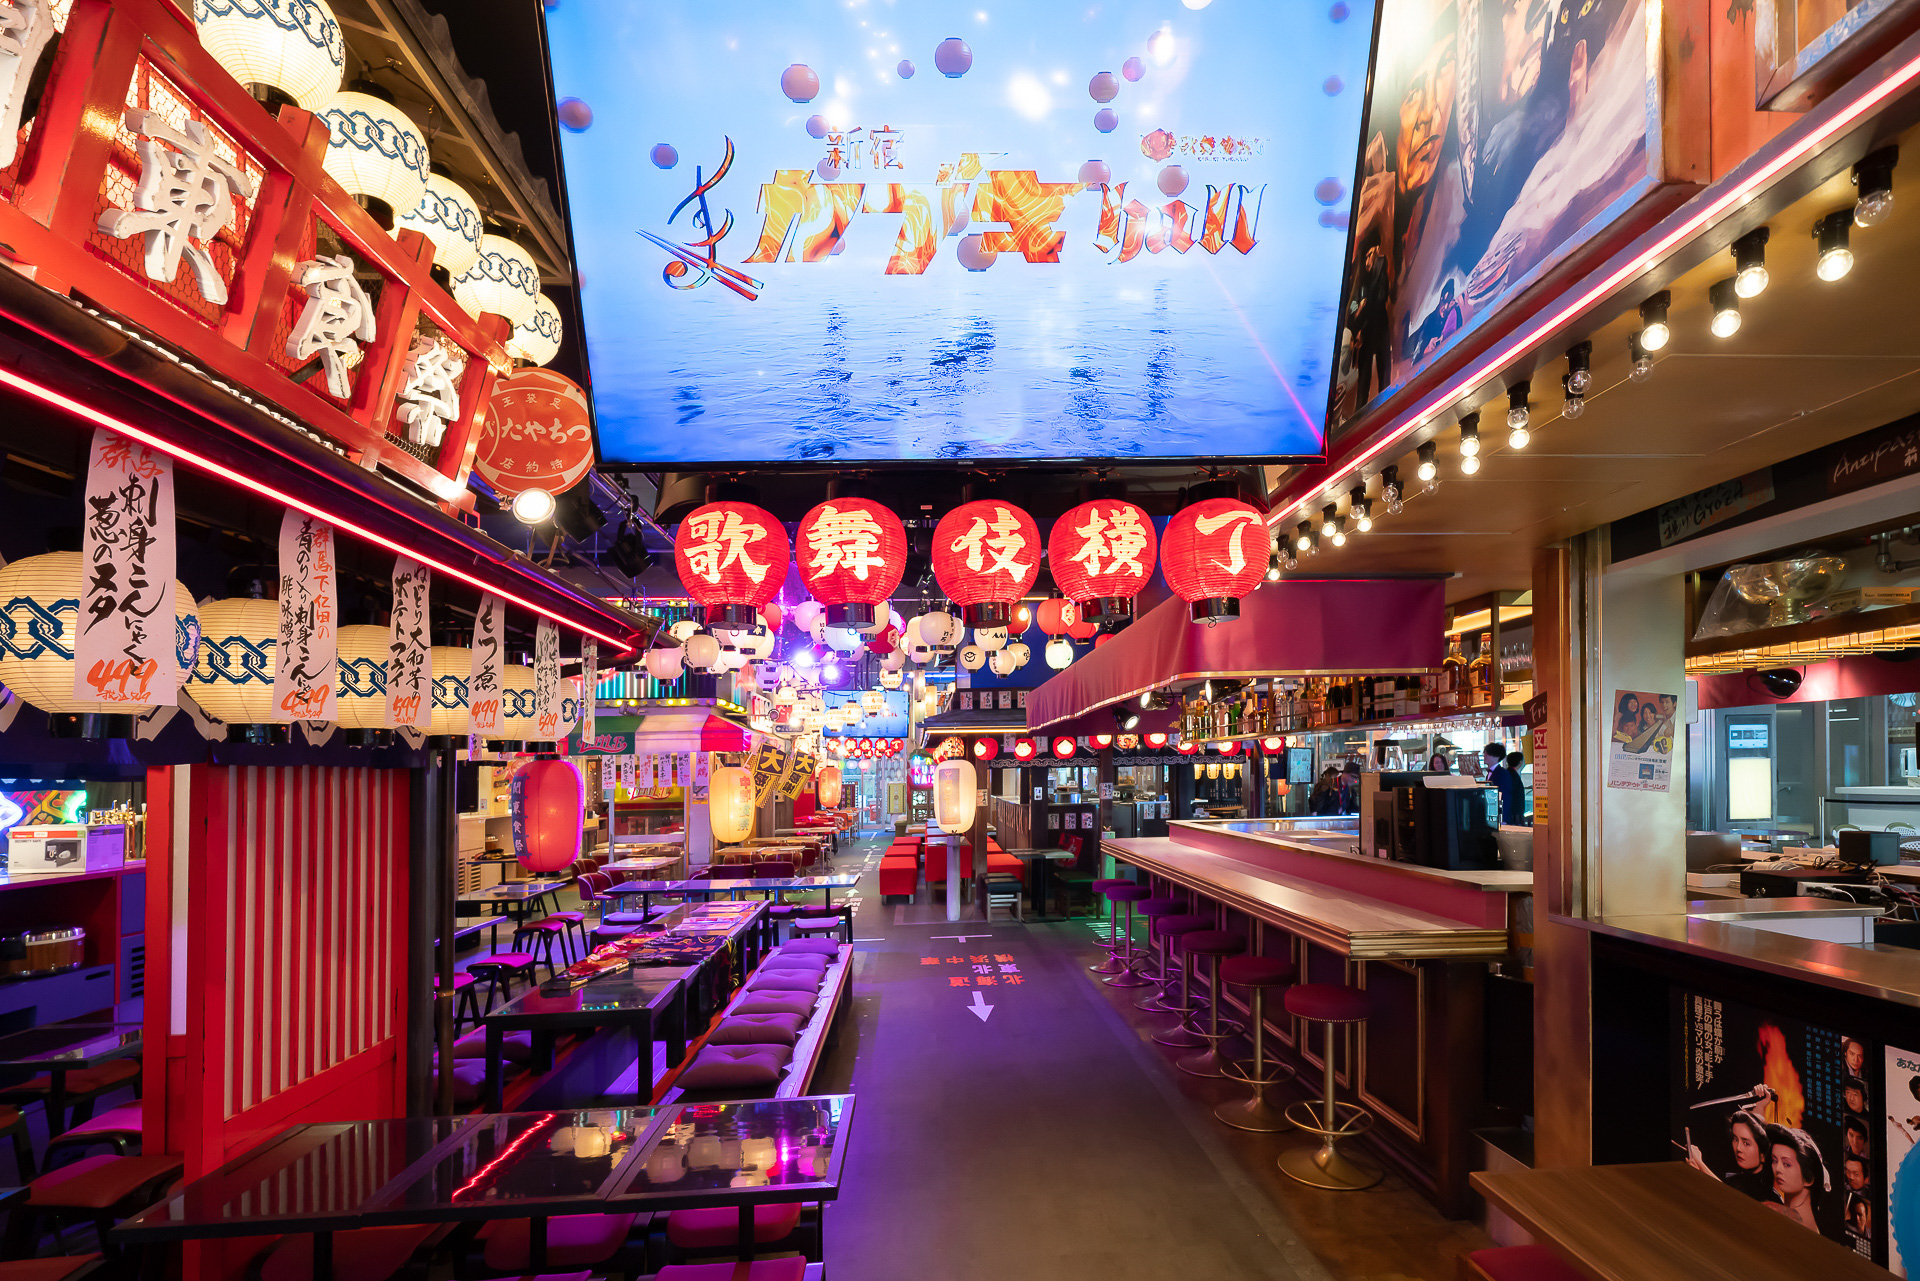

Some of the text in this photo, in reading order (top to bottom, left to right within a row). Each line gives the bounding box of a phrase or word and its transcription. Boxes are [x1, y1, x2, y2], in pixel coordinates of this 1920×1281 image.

[825, 125, 905, 170] 新宿
[682, 506, 1265, 584] 歌舞伎横丁
[86, 658, 159, 694] 499
[392, 694, 422, 718] 599
[471, 698, 499, 722] 499
